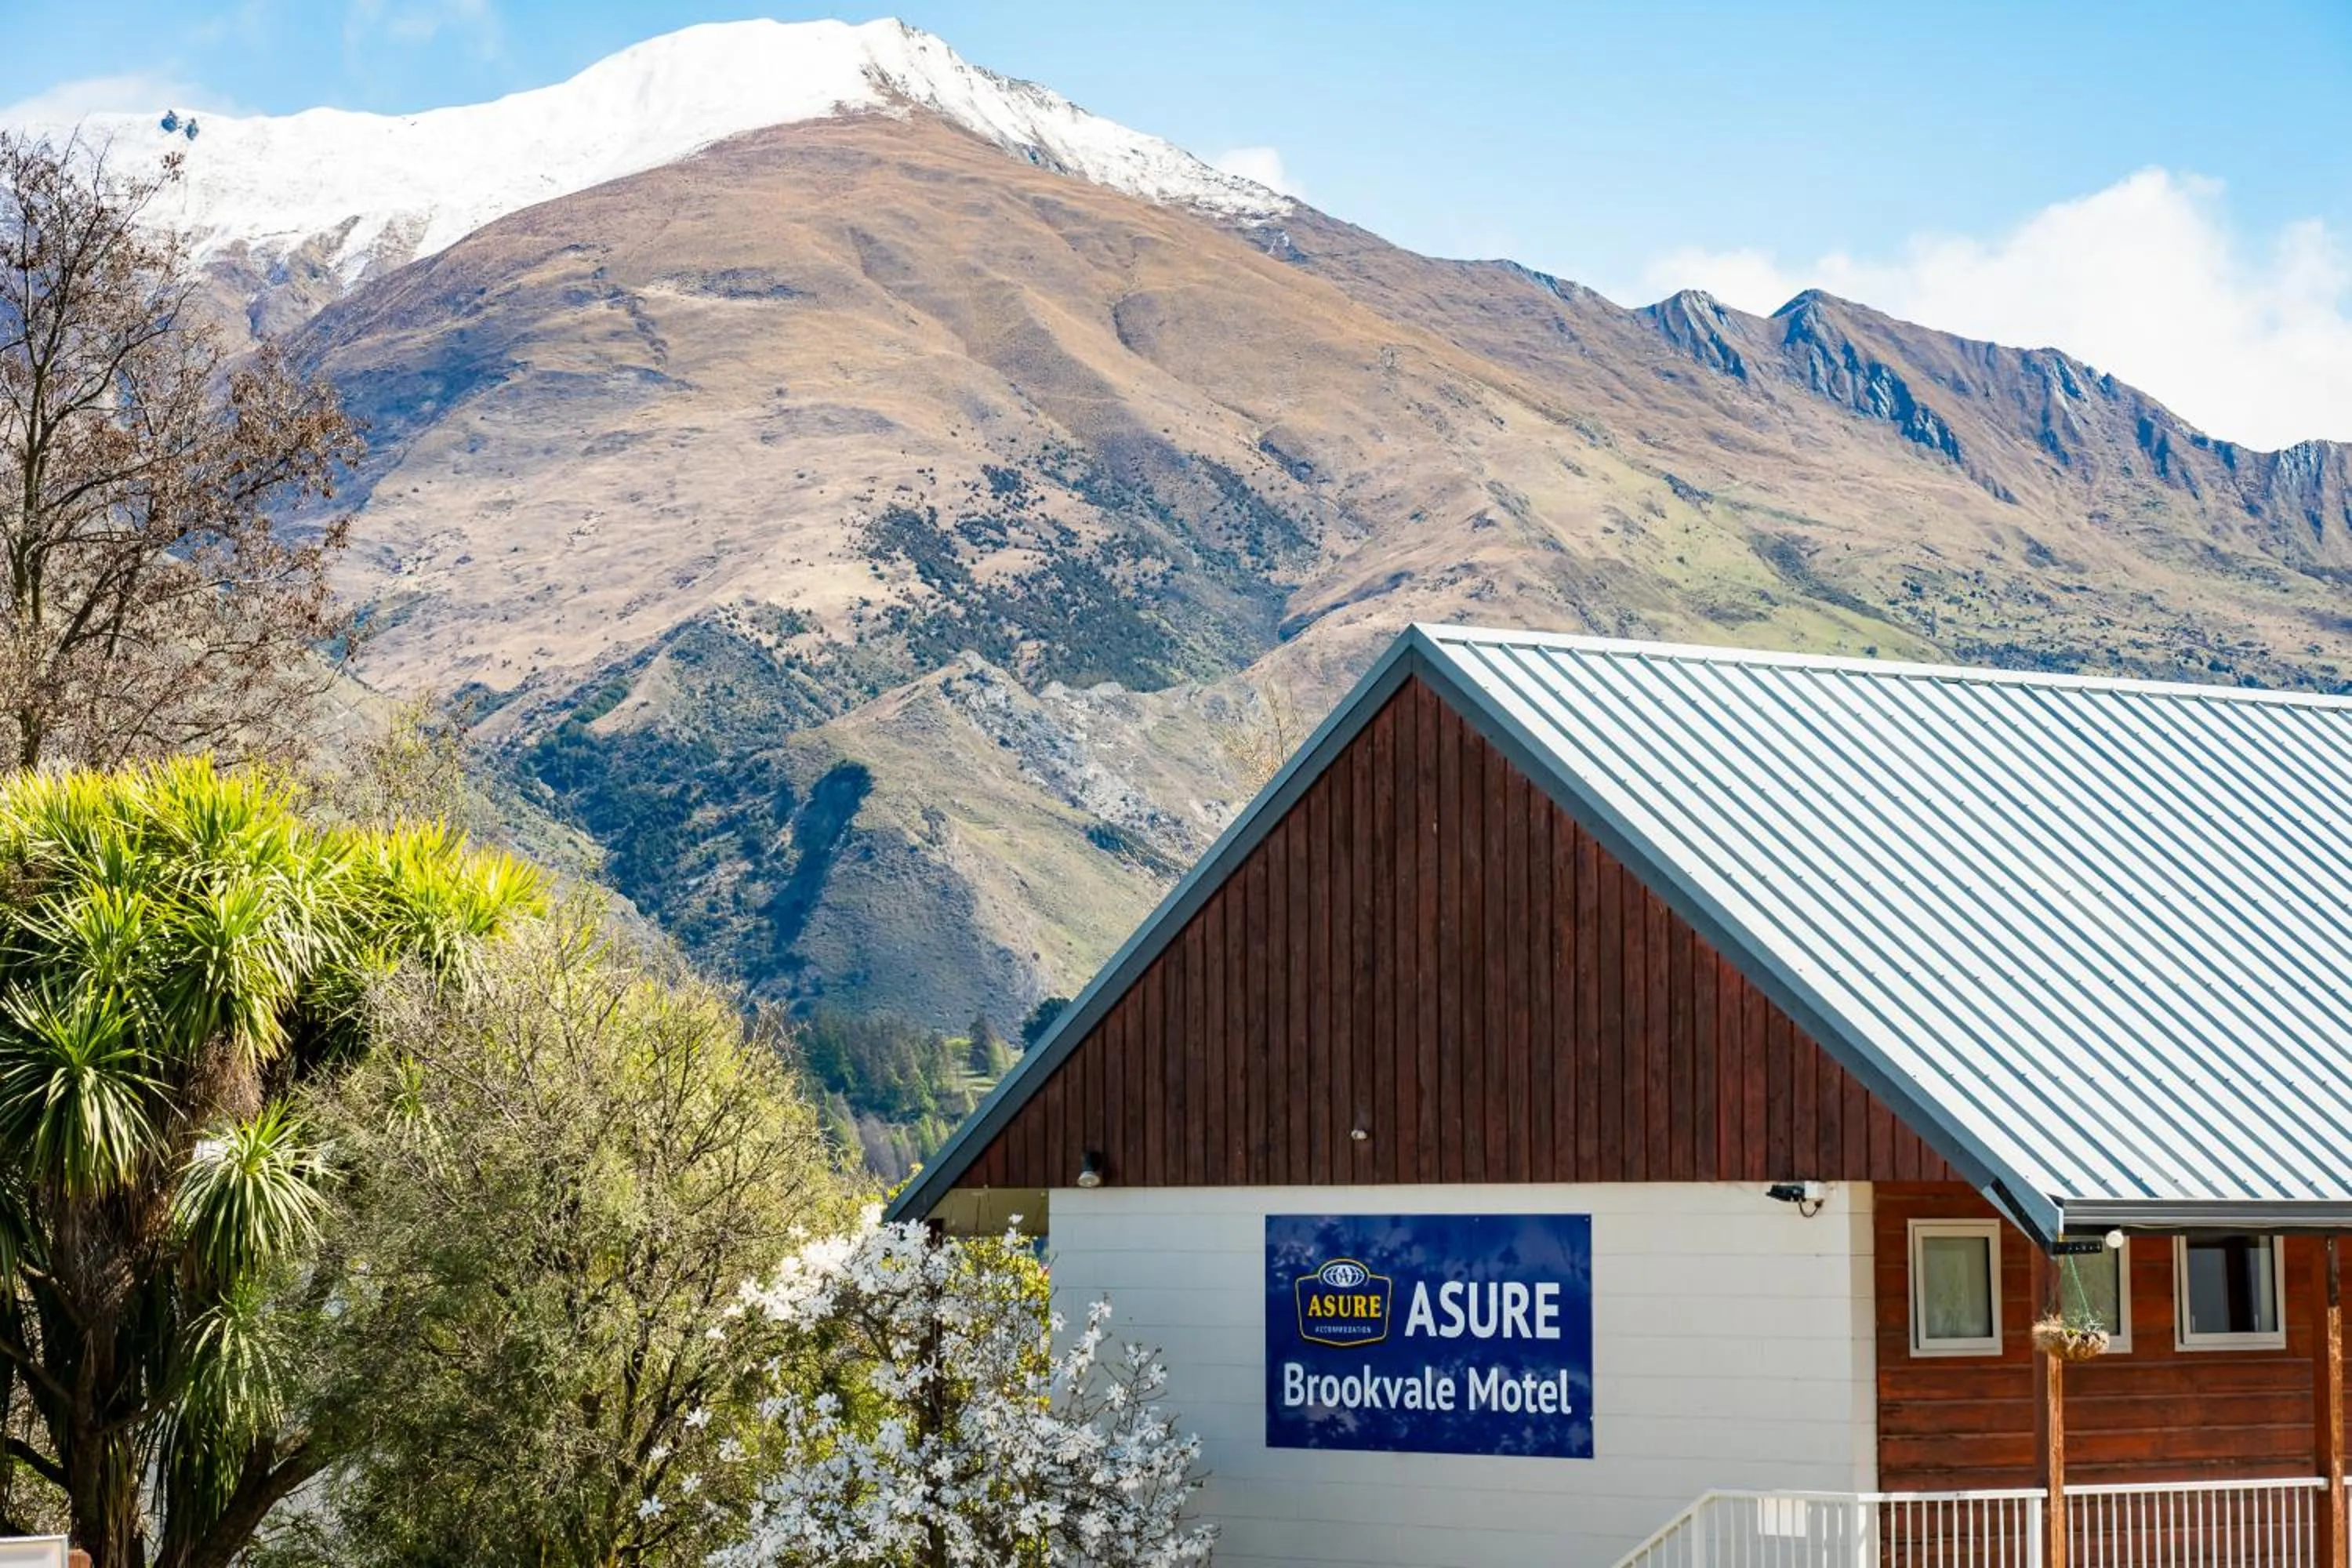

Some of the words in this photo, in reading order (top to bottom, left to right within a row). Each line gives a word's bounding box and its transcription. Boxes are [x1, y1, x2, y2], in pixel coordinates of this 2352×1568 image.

[1307, 1294, 1382, 1318] ASURE
[1404, 1280, 1560, 1339] ASURE
[1283, 1363, 1456, 1410] Brookvale
[1468, 1367, 1572, 1414] Motel
